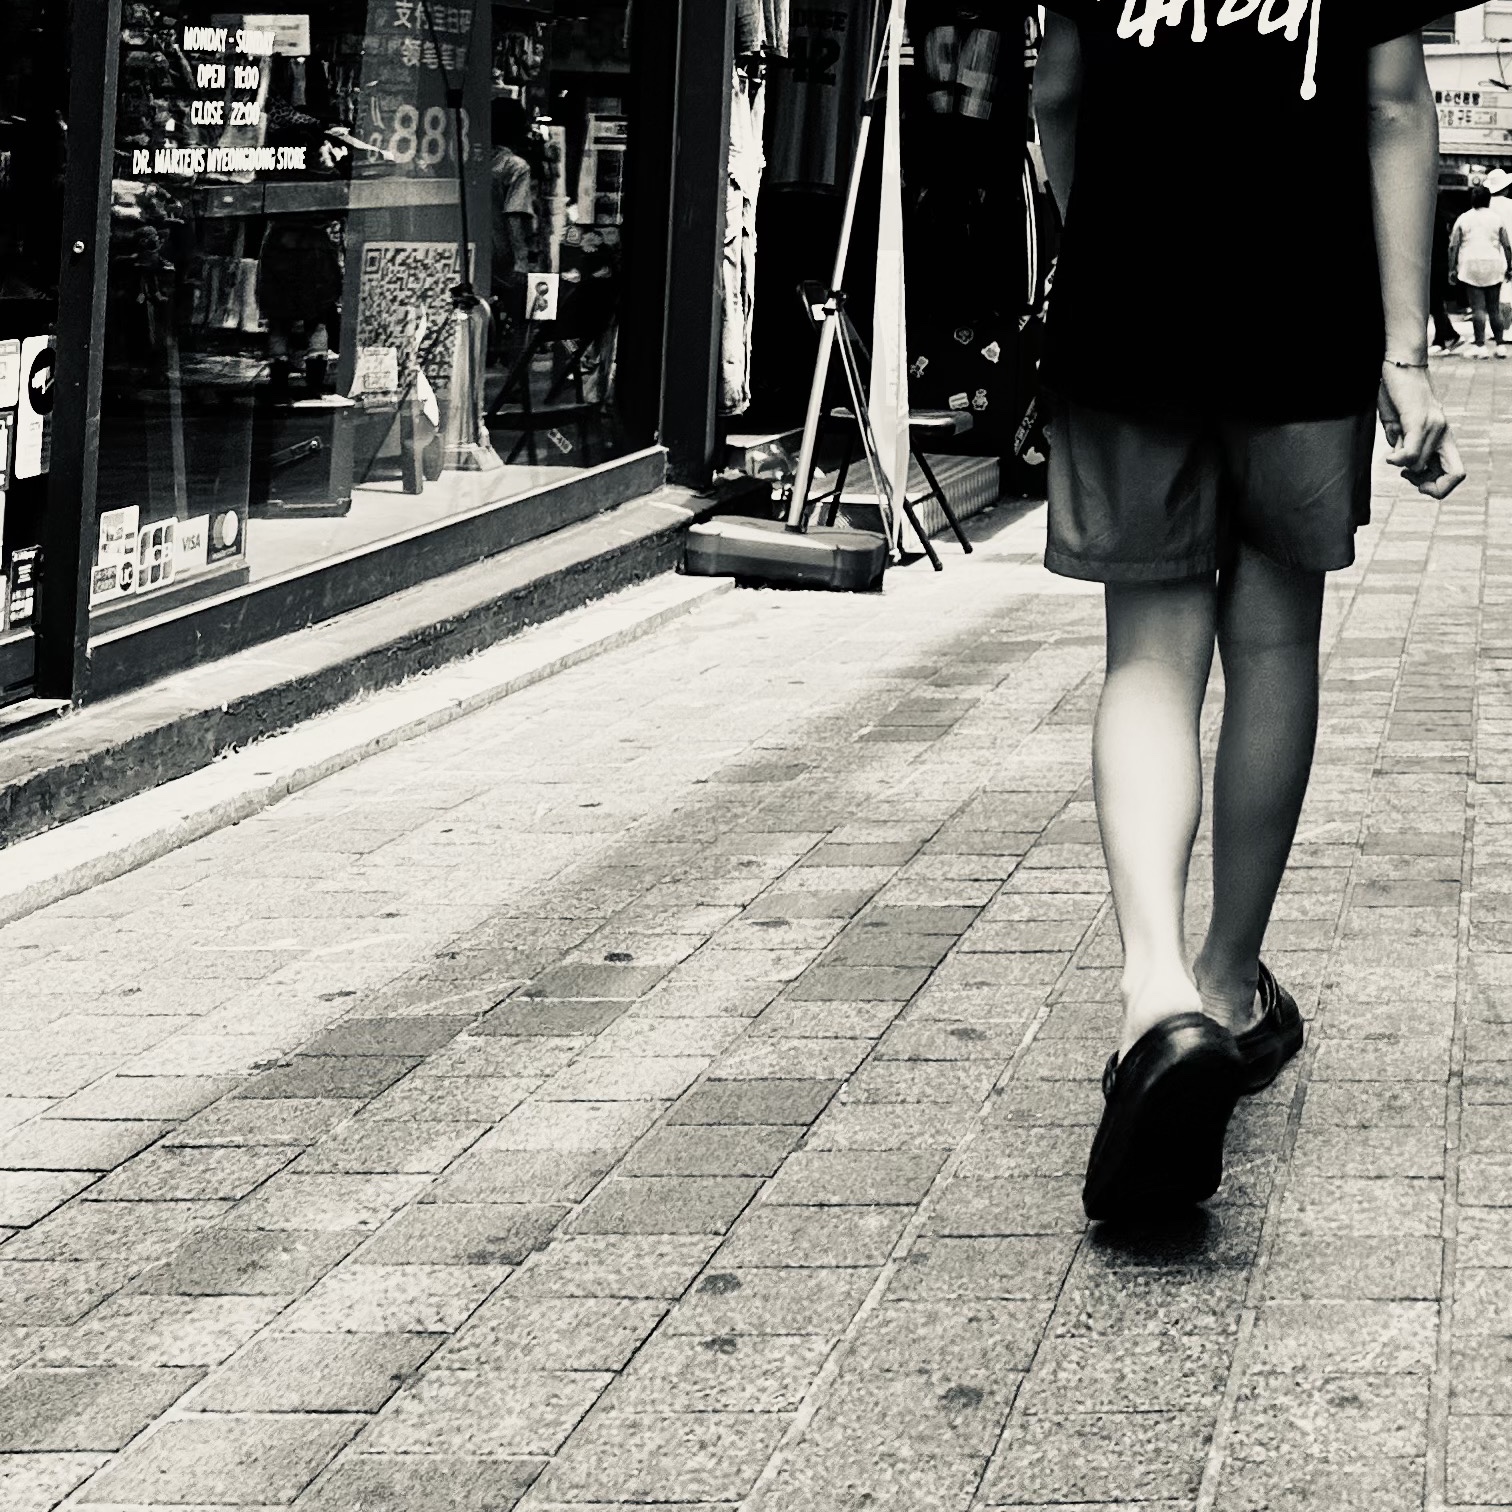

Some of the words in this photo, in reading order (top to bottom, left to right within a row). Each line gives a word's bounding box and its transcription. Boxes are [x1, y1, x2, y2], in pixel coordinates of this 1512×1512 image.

[184, 26, 228, 52] MONDAY
[236, 29, 275, 53] SUNDAY
[197, 64, 226, 88] OPEN
[191, 101, 225, 125] CLOSE
[230, 101, 260, 125] 22:00
[132, 148, 152, 174] DR.
[154, 147, 205, 174] MARTENS
[276, 146, 307, 170] STORE
[181, 531, 202, 552] VISA
